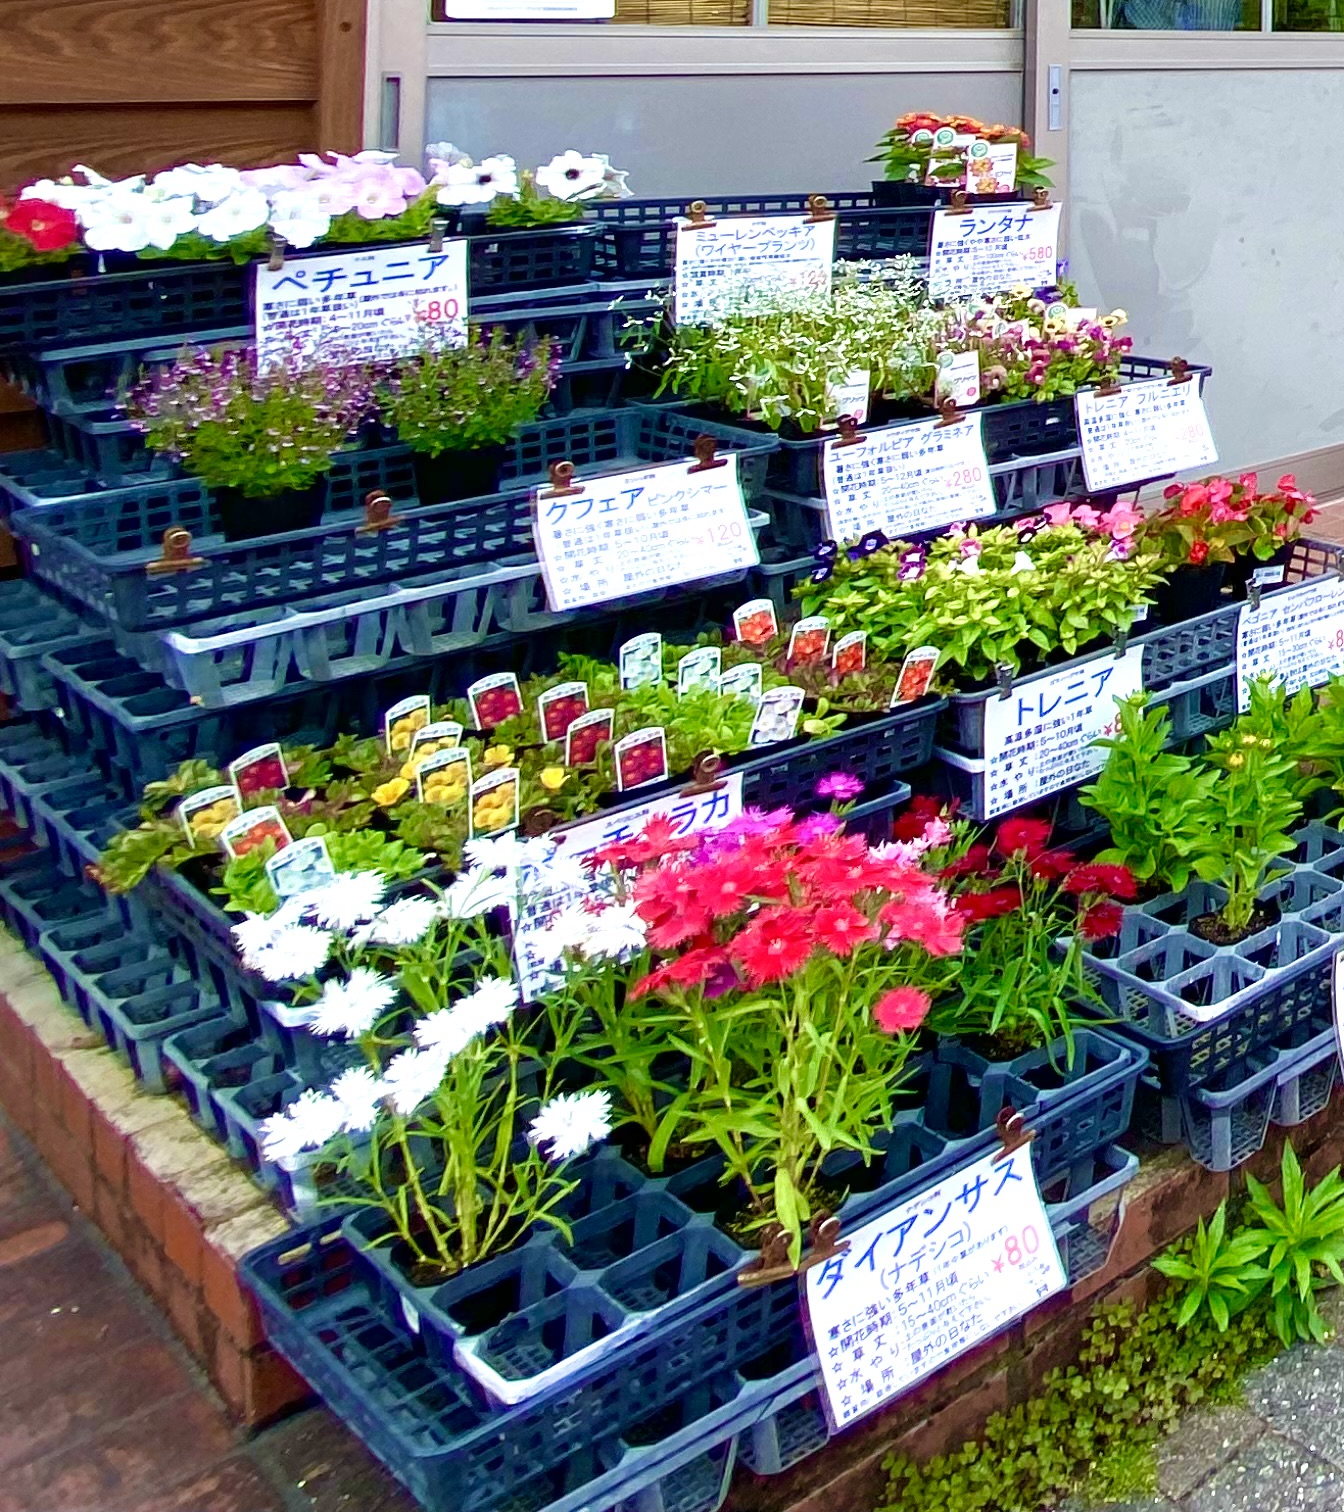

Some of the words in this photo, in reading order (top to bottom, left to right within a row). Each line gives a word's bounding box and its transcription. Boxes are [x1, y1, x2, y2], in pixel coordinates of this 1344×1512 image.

[696, 225, 815, 241] ミューレンベッキア
[959, 214, 1033, 237] ランタナ
[1023, 245, 1052, 260] ¥580
[272, 254, 448, 292] ペチュニア
[1085, 395, 1128, 412] トレニア
[1138, 384, 1190, 404] フルニエリ
[829, 436, 913, 462] ユーフォルビア
[920, 424, 973, 444] グラミネア
[945, 467, 981, 487] ¥280
[546, 486, 644, 524] クフェア
[647, 484, 727, 506] ピンクシマー
[1017, 666, 1113, 725] トレニア
[816, 1157, 1023, 1299] ダイアンサス
[880, 1221, 970, 1289] (ナデシコ)
[992, 1225, 1038, 1272] ¥80
[828, 1271, 928, 1340] 寒さに強い多年草
